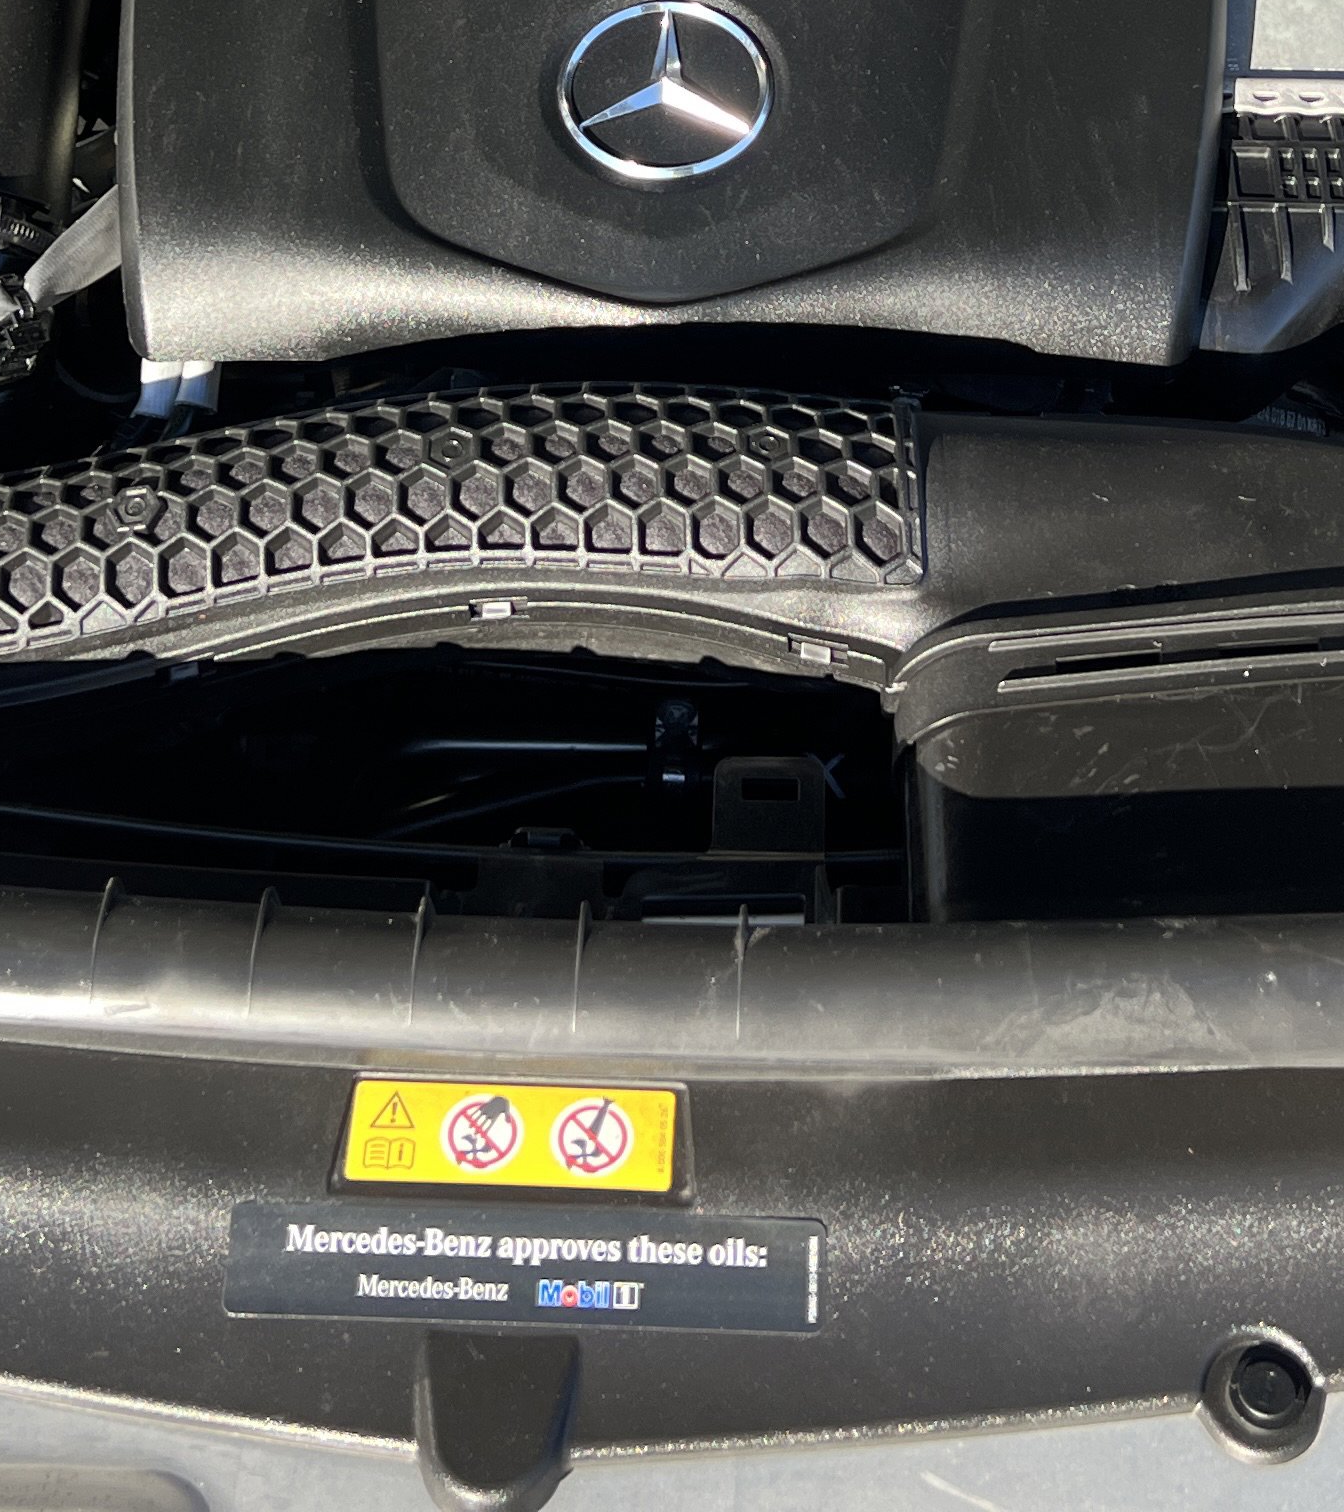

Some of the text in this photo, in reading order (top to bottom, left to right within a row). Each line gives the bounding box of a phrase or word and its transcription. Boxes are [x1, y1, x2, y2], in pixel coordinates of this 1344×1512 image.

[285, 1223, 768, 1268] Mercedes-Benz approves these oils:
[357, 1274, 509, 1301] Mercedes-Benz
[538, 1279, 611, 1308] Mobil
